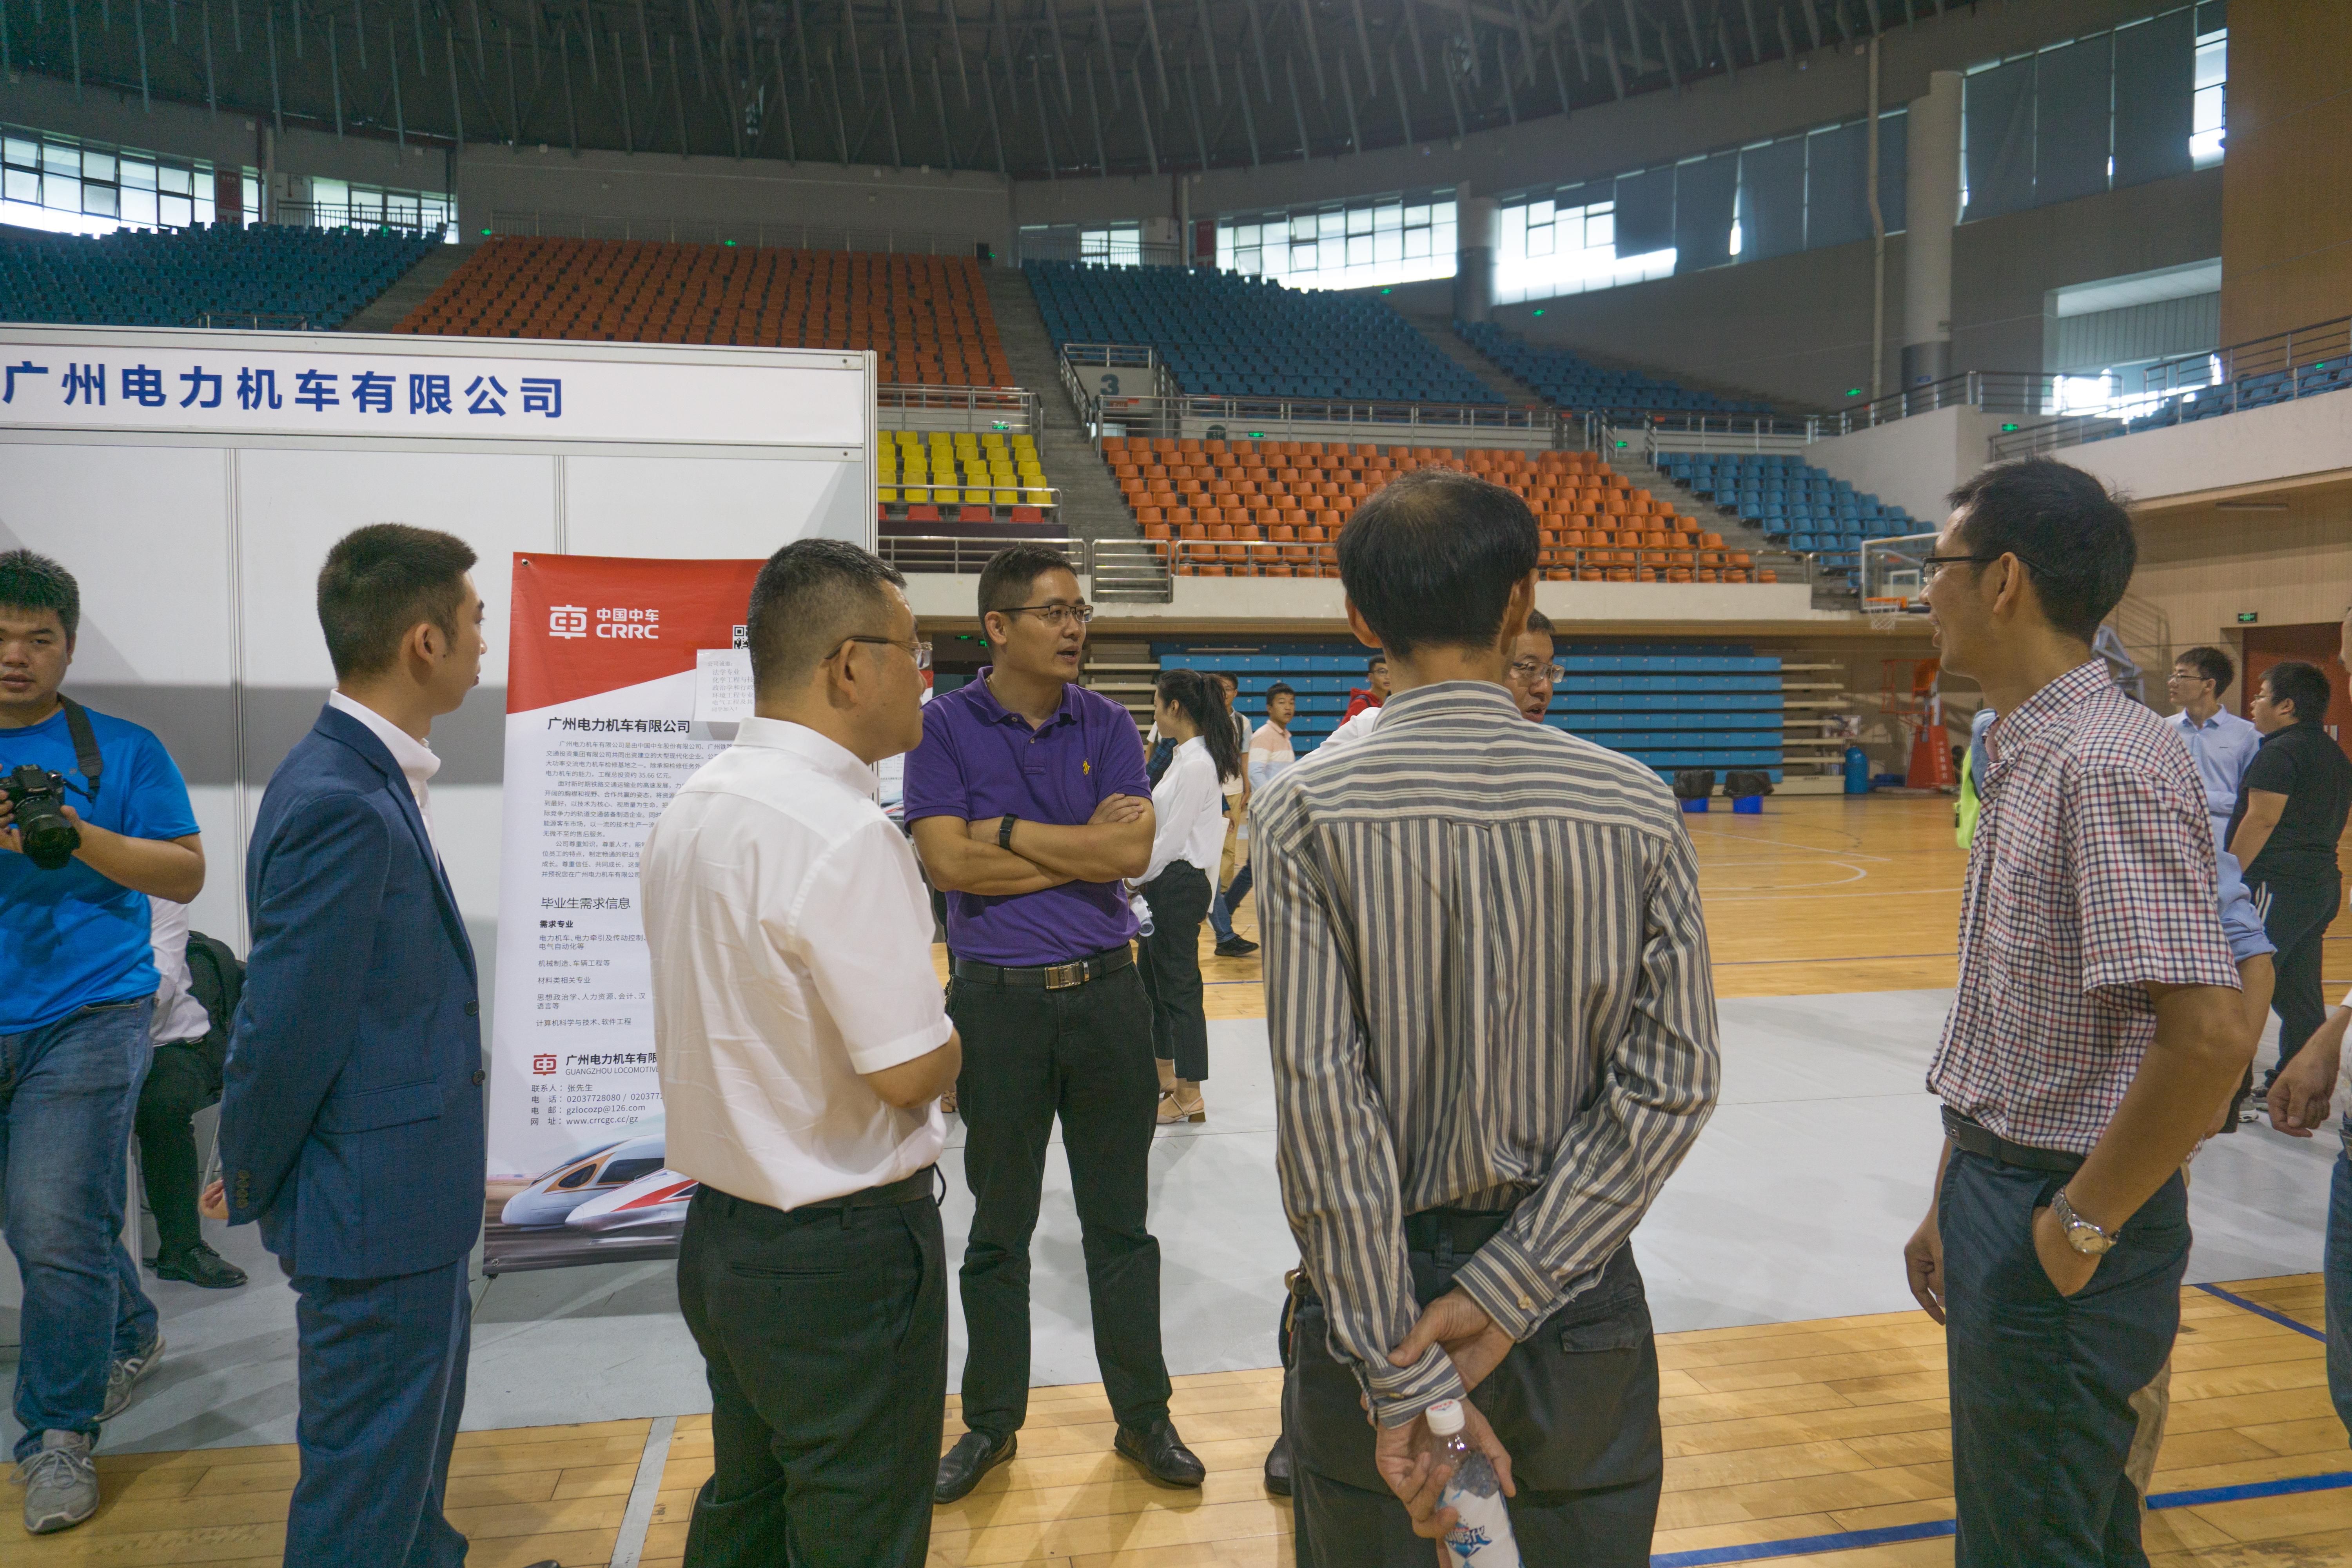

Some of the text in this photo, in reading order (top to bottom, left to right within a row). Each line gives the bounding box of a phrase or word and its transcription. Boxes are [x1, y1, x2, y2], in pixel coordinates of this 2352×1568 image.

[2, 361, 561, 417] 广州电力机车有限公司
[1100, 373, 1120, 396] 3
[597, 608, 659, 622] 中国中车
[596, 624, 659, 639] CRRC
[548, 717, 690, 733] 广州电力机车有限公司
[558, 780, 684, 789] 面对新时期铁路交通运输业的高速发展，力
[544, 790, 676, 799] 开阔的胸襟和视野、合作共赢的姿态，将资源
[541, 897, 631, 909] 毕业生需求信息
[539, 920, 573, 928] 需求专业
[566, 1053, 657, 1066] 广州电力机车有限
[567, 1094, 621, 1103] 02037728080
[566, 1104, 646, 1116] gzlocozp@126.com
[566, 1115, 639, 1125] www.crrcgc.cc/gz
